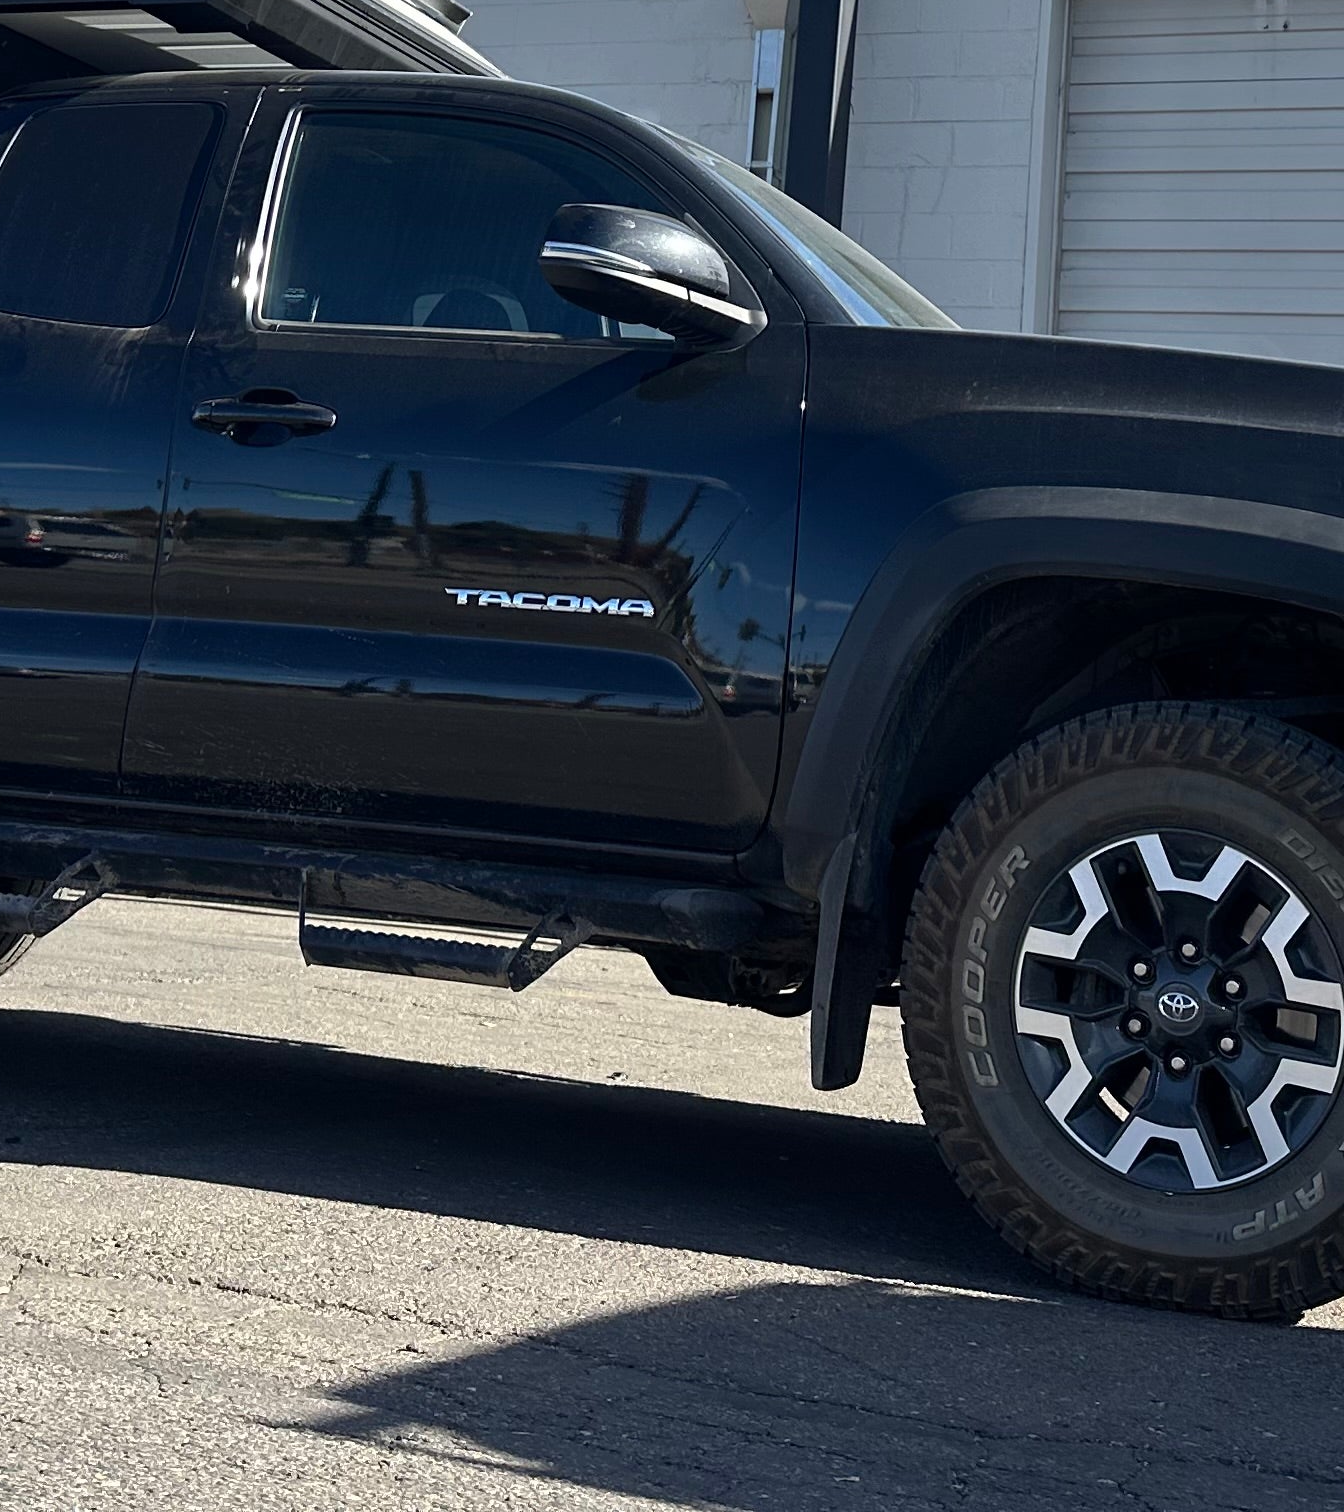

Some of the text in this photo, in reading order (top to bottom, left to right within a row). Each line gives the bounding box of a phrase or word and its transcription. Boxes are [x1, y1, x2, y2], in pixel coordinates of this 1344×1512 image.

[444, 587, 655, 618] TACOMA
[960, 843, 1034, 1088] COOPER
[1231, 1171, 1327, 1241] ATP
